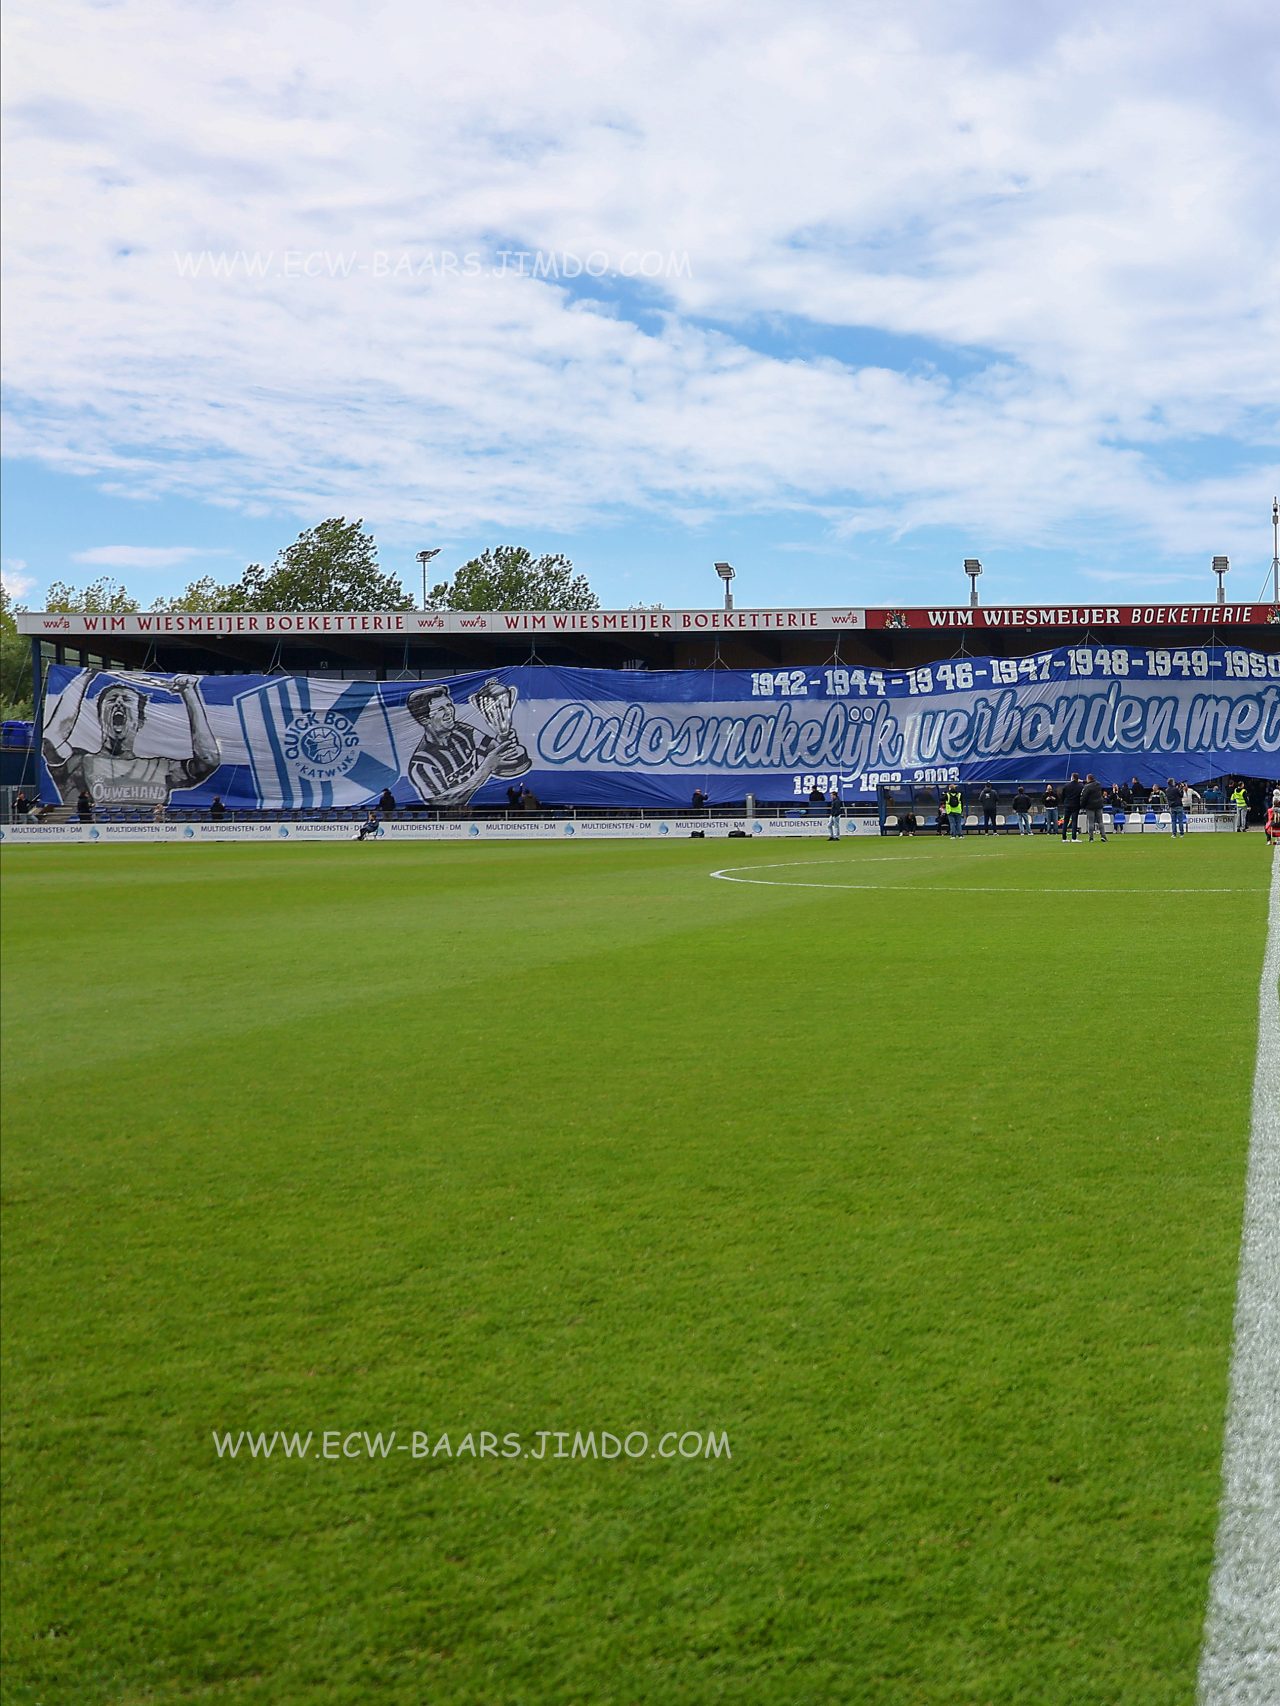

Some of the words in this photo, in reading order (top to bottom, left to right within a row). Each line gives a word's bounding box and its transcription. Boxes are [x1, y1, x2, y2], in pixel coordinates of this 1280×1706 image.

[83, 617, 125, 631] WIM
[137, 616, 259, 633] WIESMEIJER
[266, 615, 404, 630] BOEKETTERIE
[504, 615, 546, 629] WIM
[552, 614, 672, 631] WIESMEIJER
[682, 612, 818, 628] BOEKETTERIE
[927, 611, 974, 626] WIM
[983, 608, 1120, 625] WIESMEIJER
[1131, 607, 1252, 623] BOEKETTERIE
[283, 711, 320, 760] QUICK
[324, 711, 360, 748] BOYS
[537, 700, 903, 782] Onlosmakelijk
[917, 680, 1181, 765] verbonden
